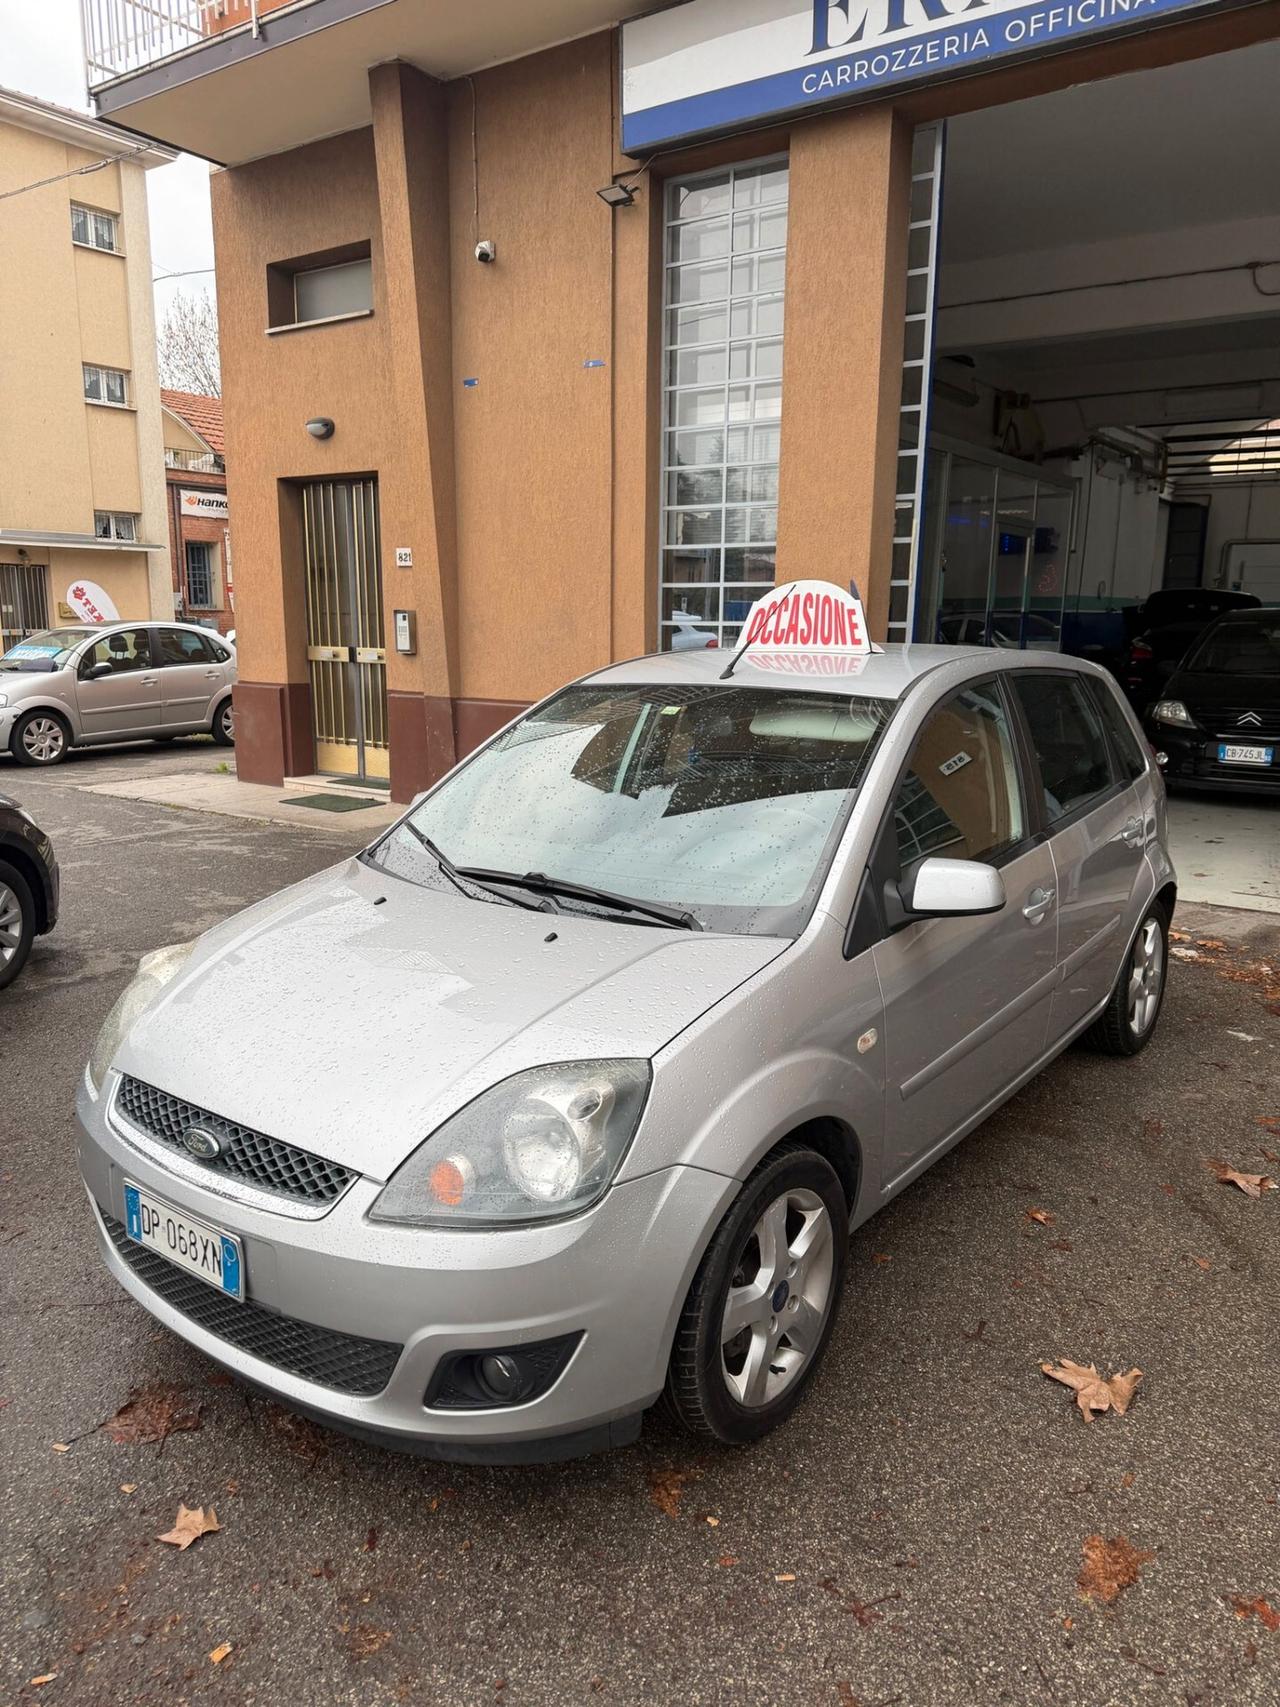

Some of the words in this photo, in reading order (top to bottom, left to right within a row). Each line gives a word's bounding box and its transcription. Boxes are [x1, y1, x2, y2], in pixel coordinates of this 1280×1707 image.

[802, 28, 990, 93] CARROZZERIA
[398, 552, 411, 562] 821
[746, 592, 862, 646] OCCASIONE
[141, 1203, 160, 1239] DP
[166, 1218, 222, 1278] 068XN
